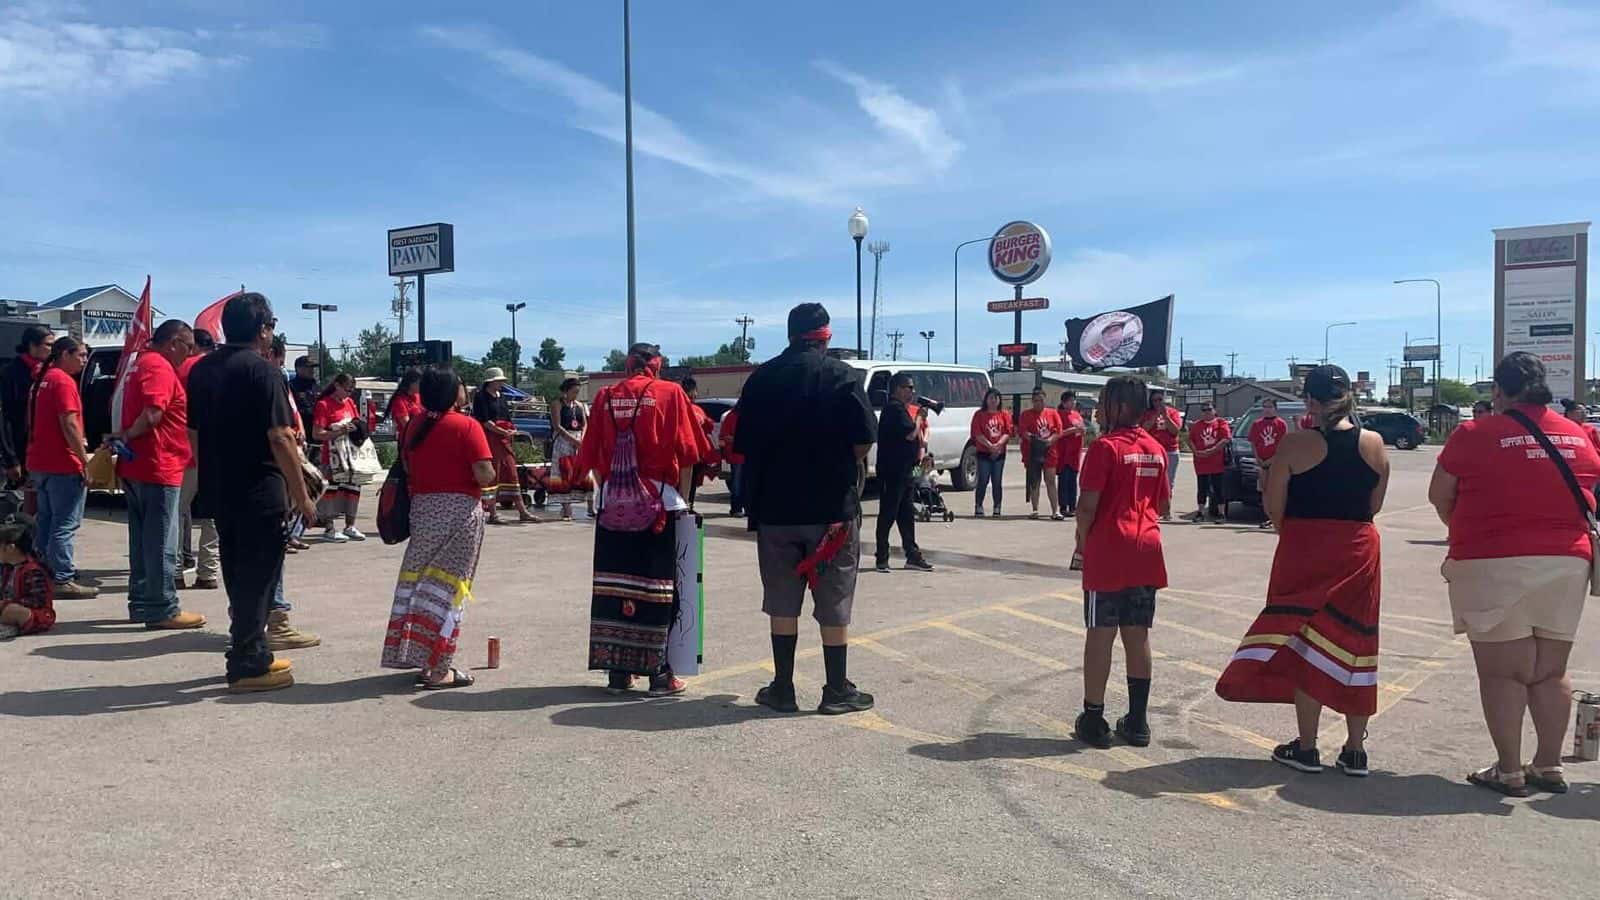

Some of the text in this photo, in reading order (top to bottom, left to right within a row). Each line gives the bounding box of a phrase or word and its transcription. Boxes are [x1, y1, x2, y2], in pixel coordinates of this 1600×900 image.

[995, 233, 1040, 252] BURGER
[393, 244, 438, 267] PAWN
[995, 244, 1041, 268] KING
[87, 310, 104, 318] FIRST
[992, 300, 1042, 310] BREAKFAST
